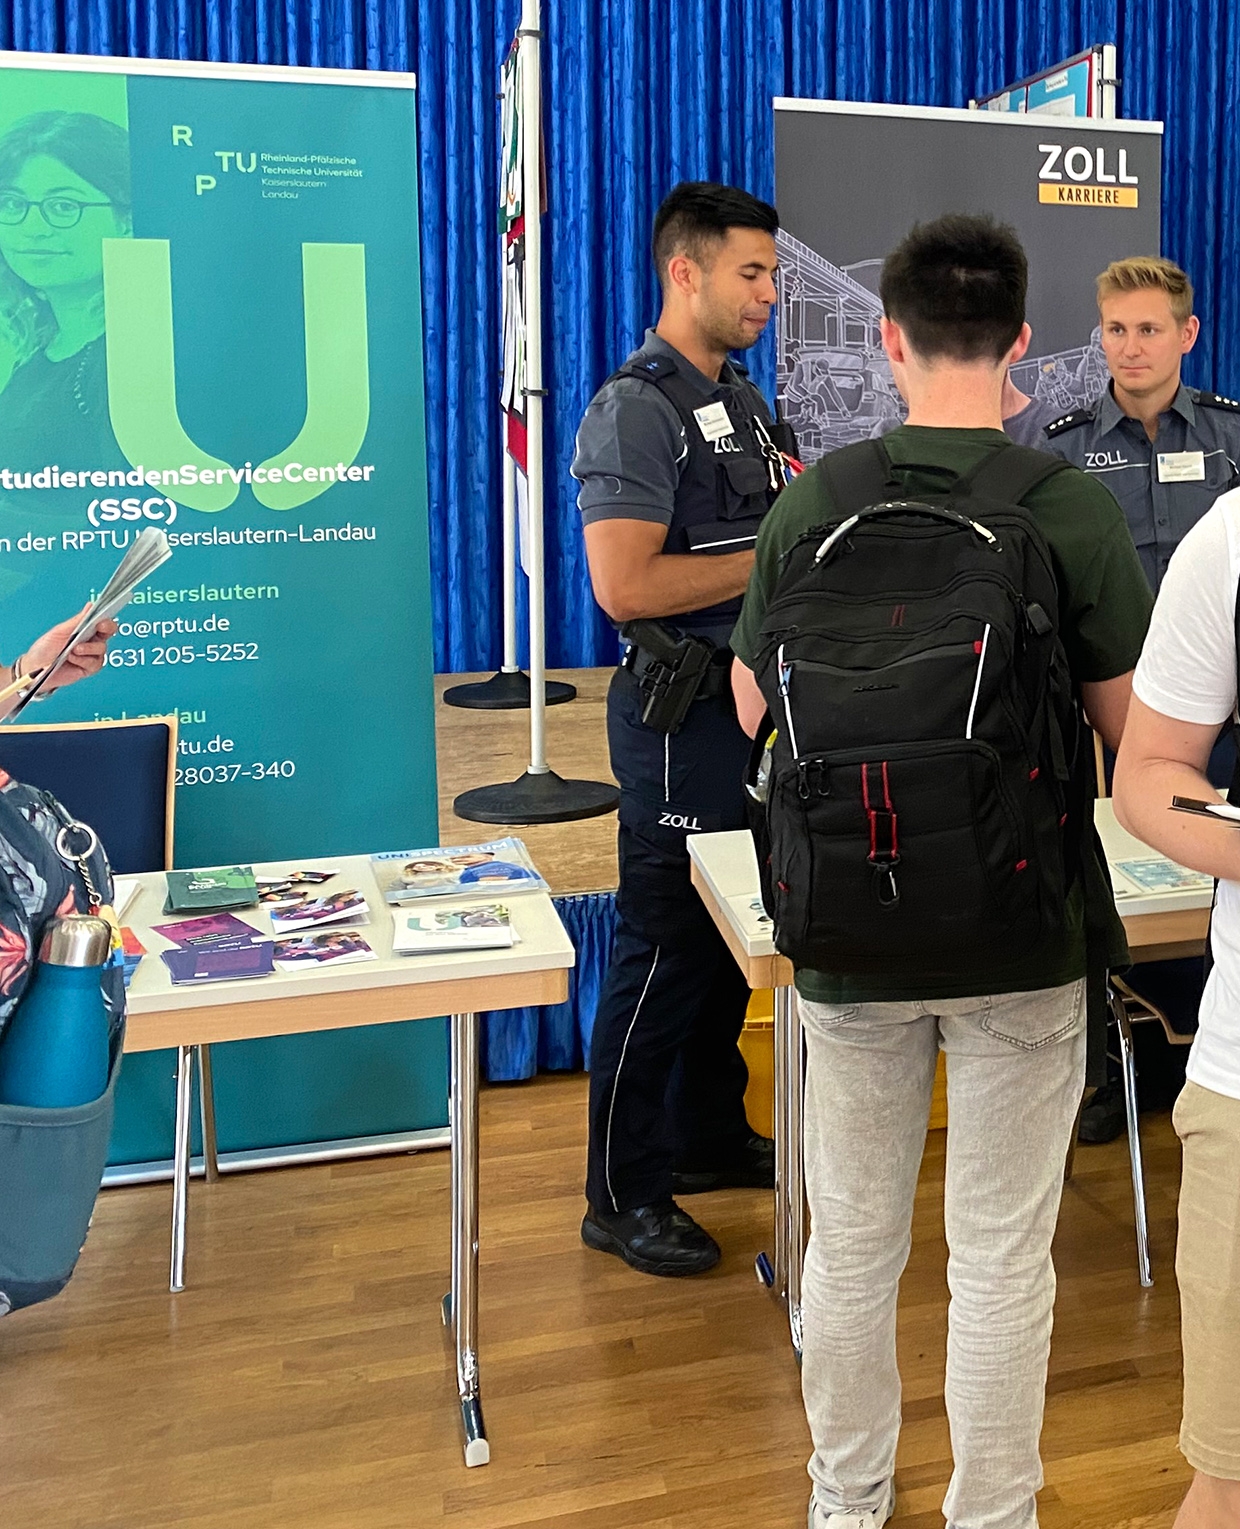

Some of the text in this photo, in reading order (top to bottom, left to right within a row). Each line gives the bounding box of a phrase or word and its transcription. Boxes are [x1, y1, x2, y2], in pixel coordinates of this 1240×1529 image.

[172, 125, 193, 146] R
[215, 151, 256, 173] TU
[260, 153, 357, 165] Rheinland-Pfälzische
[1038, 144, 1139, 184] ZOLL
[261, 165, 363, 178] Technische Universität
[195, 175, 217, 196] P
[261, 178, 327, 187] Kaiserslautern
[262, 190, 299, 199] Landau
[1058, 186, 1120, 204] KARRIERE
[1084, 450, 1128, 467] ZOLL
[0, 462, 375, 490] tudierendenServiceCenter
[87, 498, 178, 527] (SSC)
[17, 532, 57, 552] der
[62, 529, 129, 550] RPTU
[128, 582, 279, 605] aiserslautern
[151, 642, 259, 665] 205-5252
[658, 812, 702, 830] ZOLL
[378, 841, 508, 860] UNISPECTRUM
